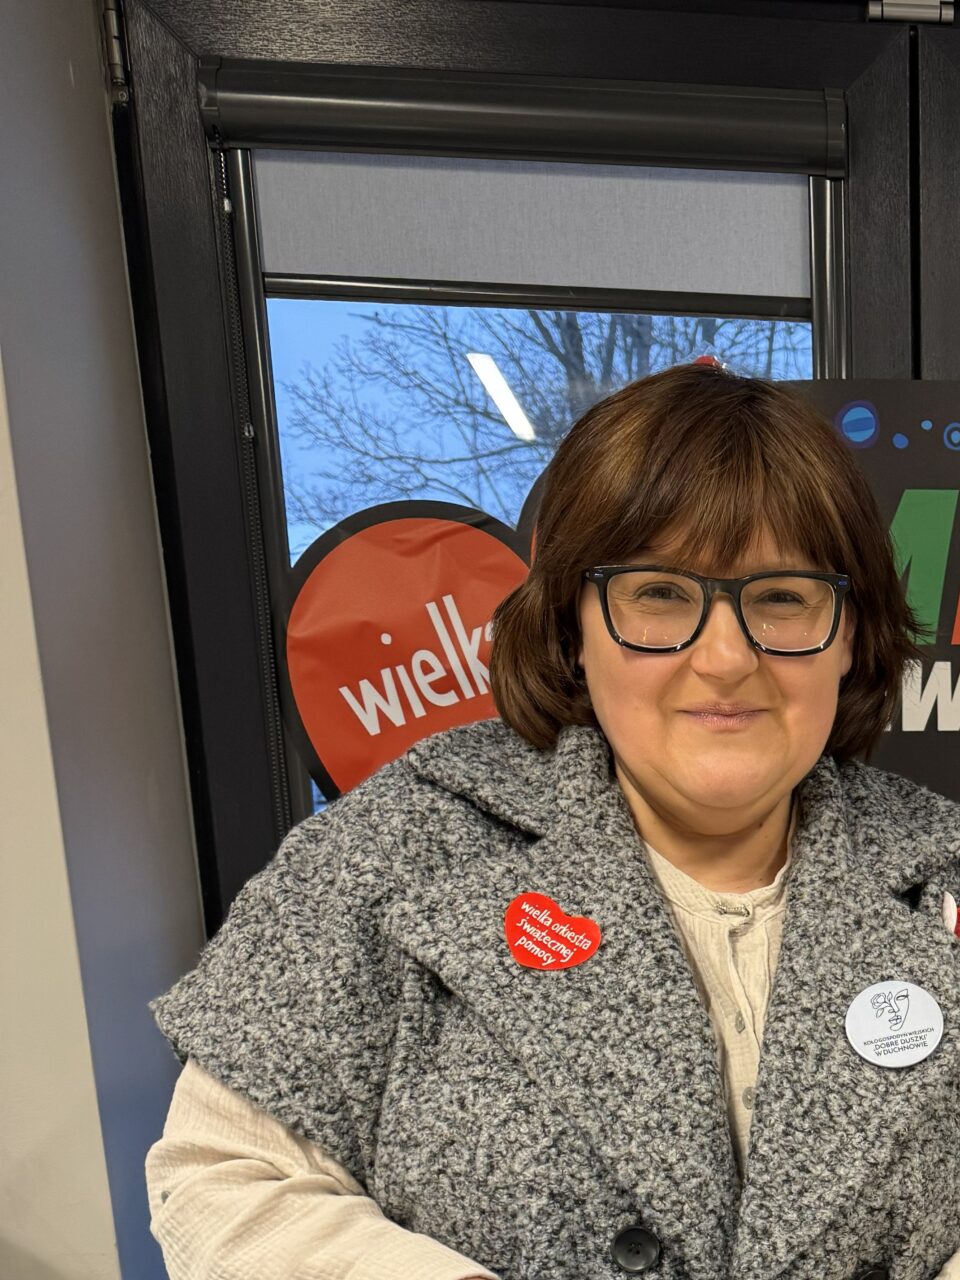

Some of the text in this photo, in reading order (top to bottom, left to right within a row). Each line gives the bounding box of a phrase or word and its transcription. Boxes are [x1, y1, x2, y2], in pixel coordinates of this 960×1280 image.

[338, 594, 493, 736] wielk
[516, 916, 577, 963] świątecznej
[520, 901, 592, 951] wielka orkiestra
[514, 936, 557, 967] pomocy
[883, 1041, 928, 1055] DUCHNOWIE
